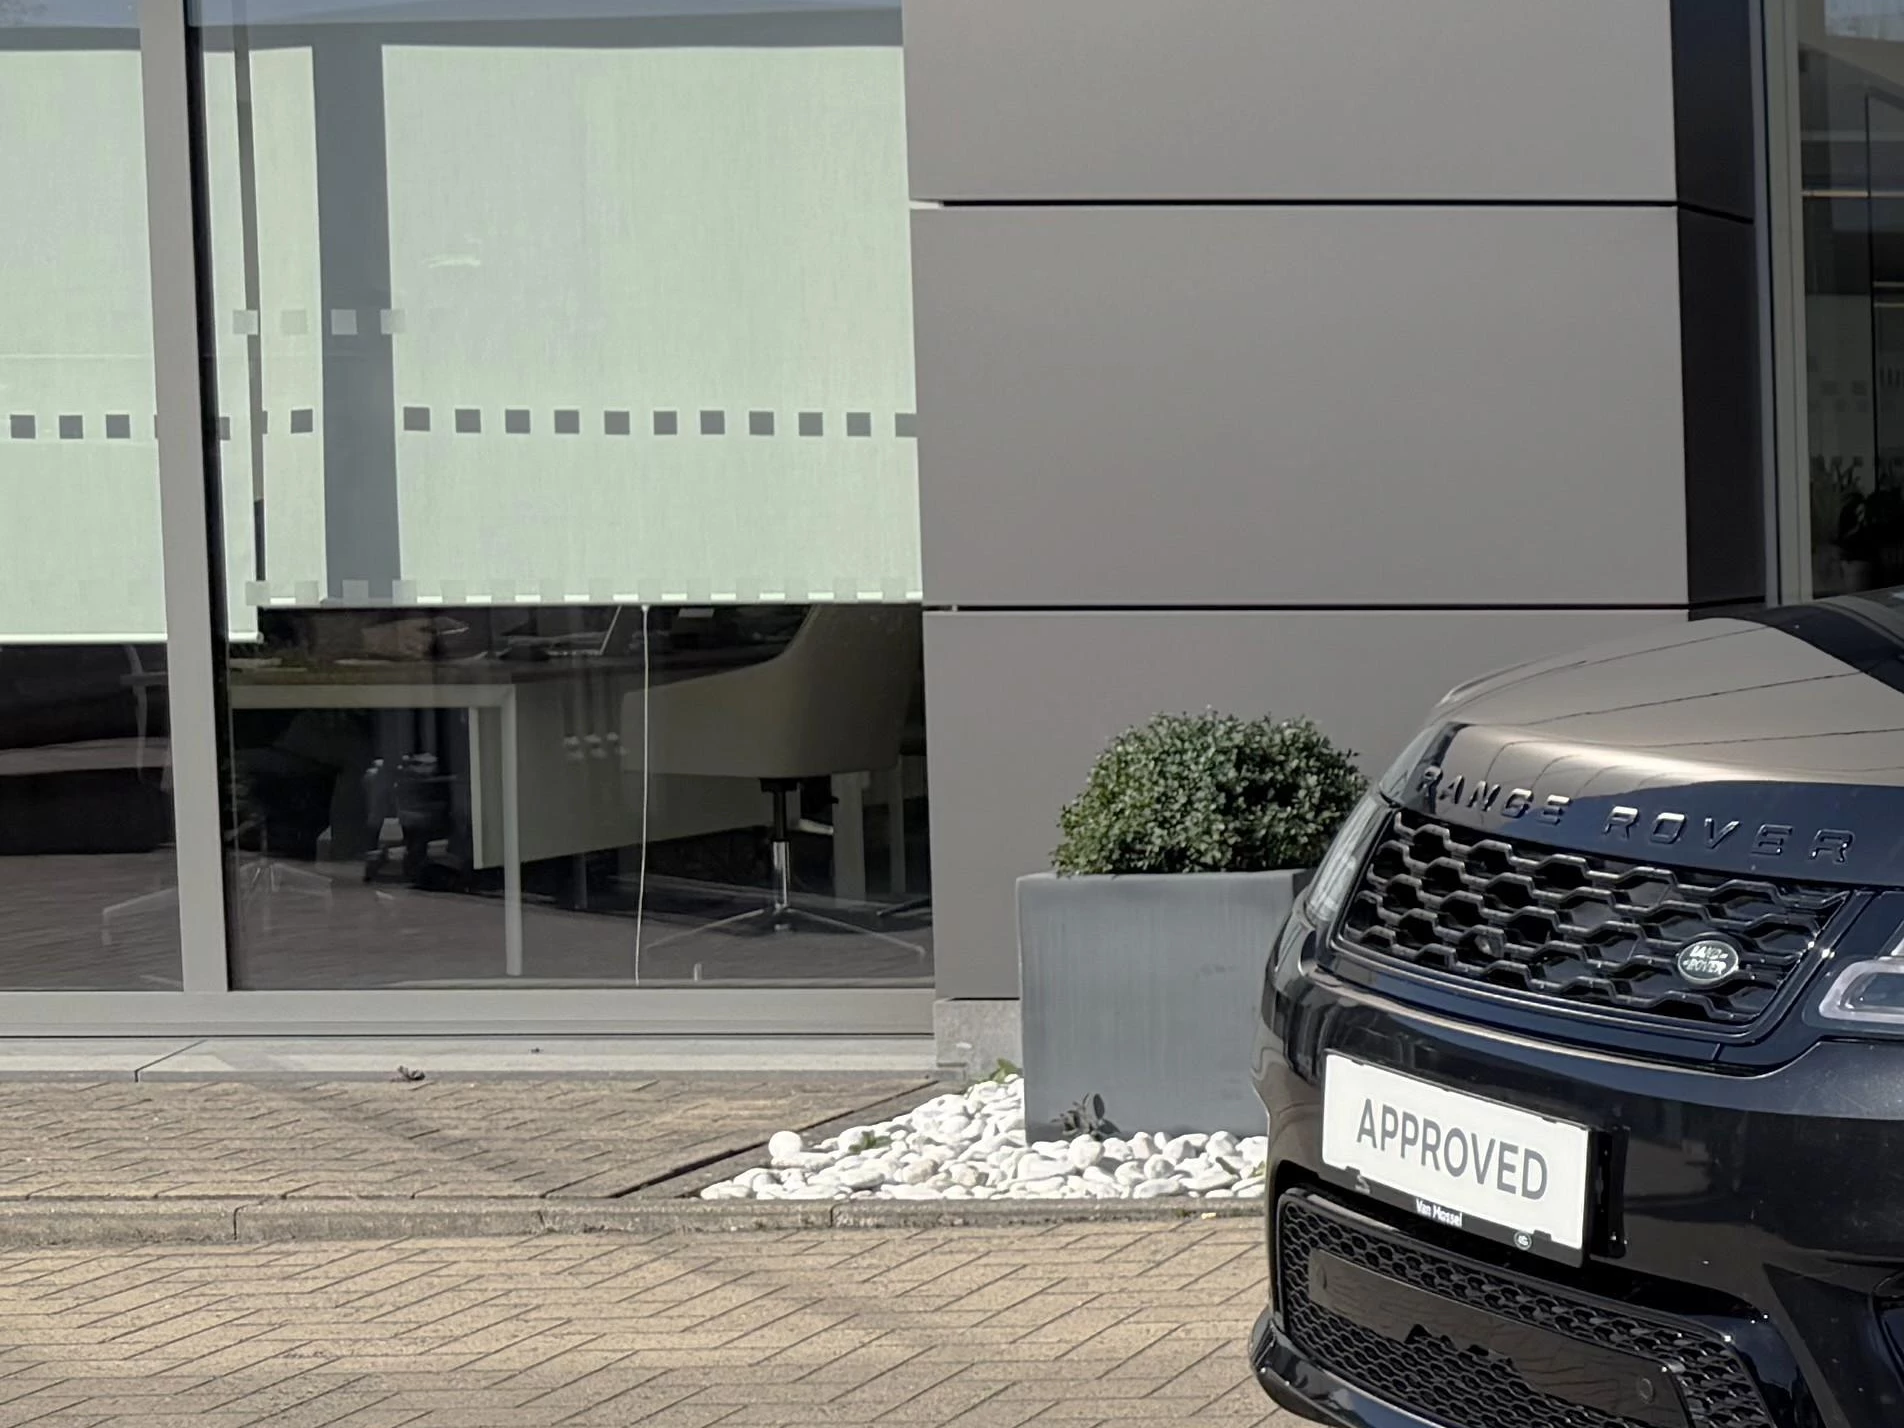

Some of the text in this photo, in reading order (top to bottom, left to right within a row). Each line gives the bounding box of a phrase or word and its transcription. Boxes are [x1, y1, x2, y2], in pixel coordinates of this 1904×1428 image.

[1416, 766, 1856, 864] RANGE ROVER
[1356, 1098, 1548, 1200] APPROVED
